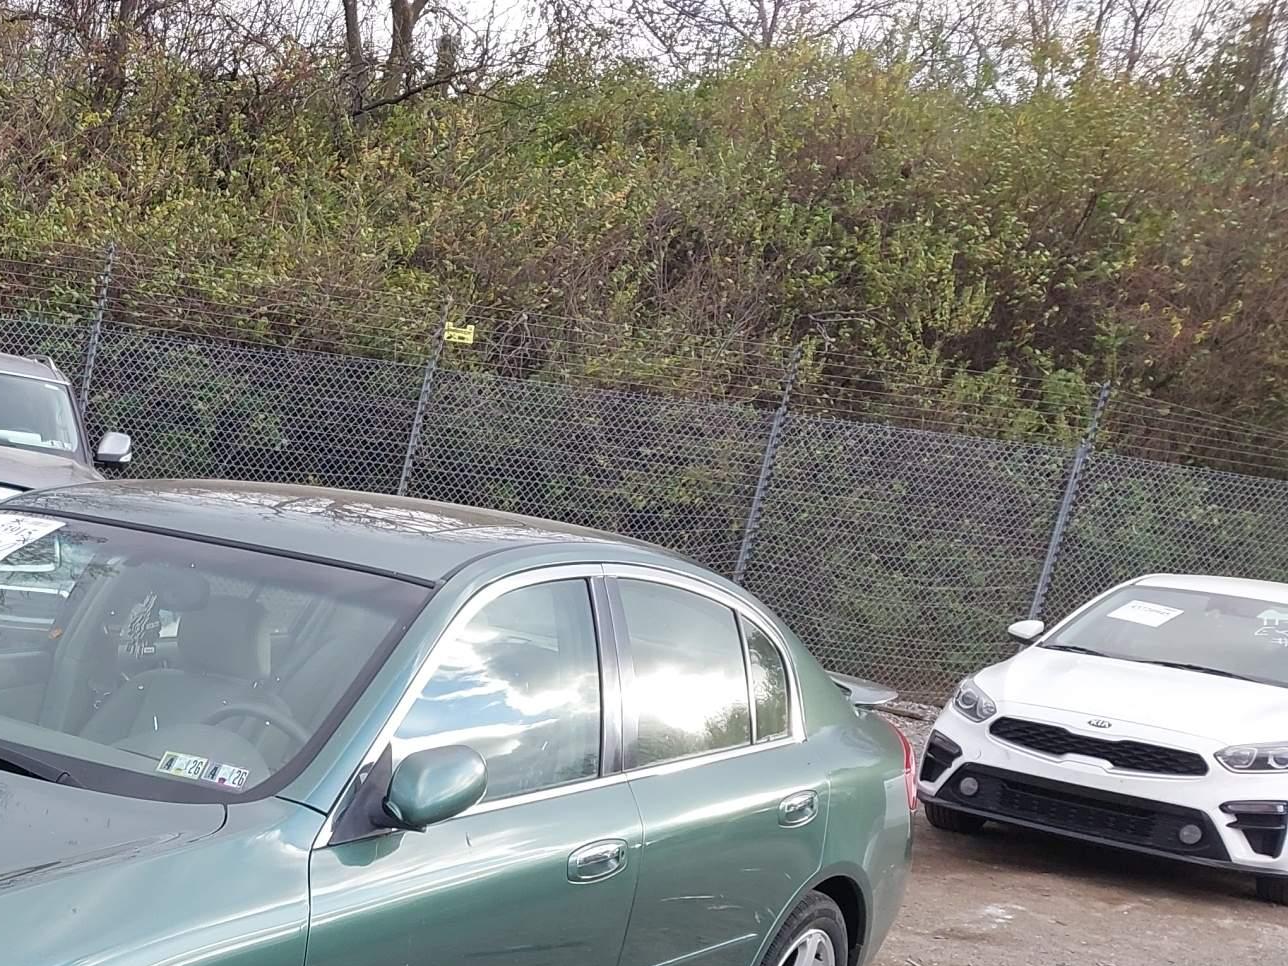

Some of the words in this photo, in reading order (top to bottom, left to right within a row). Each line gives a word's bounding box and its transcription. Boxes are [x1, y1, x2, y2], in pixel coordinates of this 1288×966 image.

[1089, 719, 1110, 728] KIA
[188, 759, 203, 775] 26
[232, 770, 247, 786] 26
